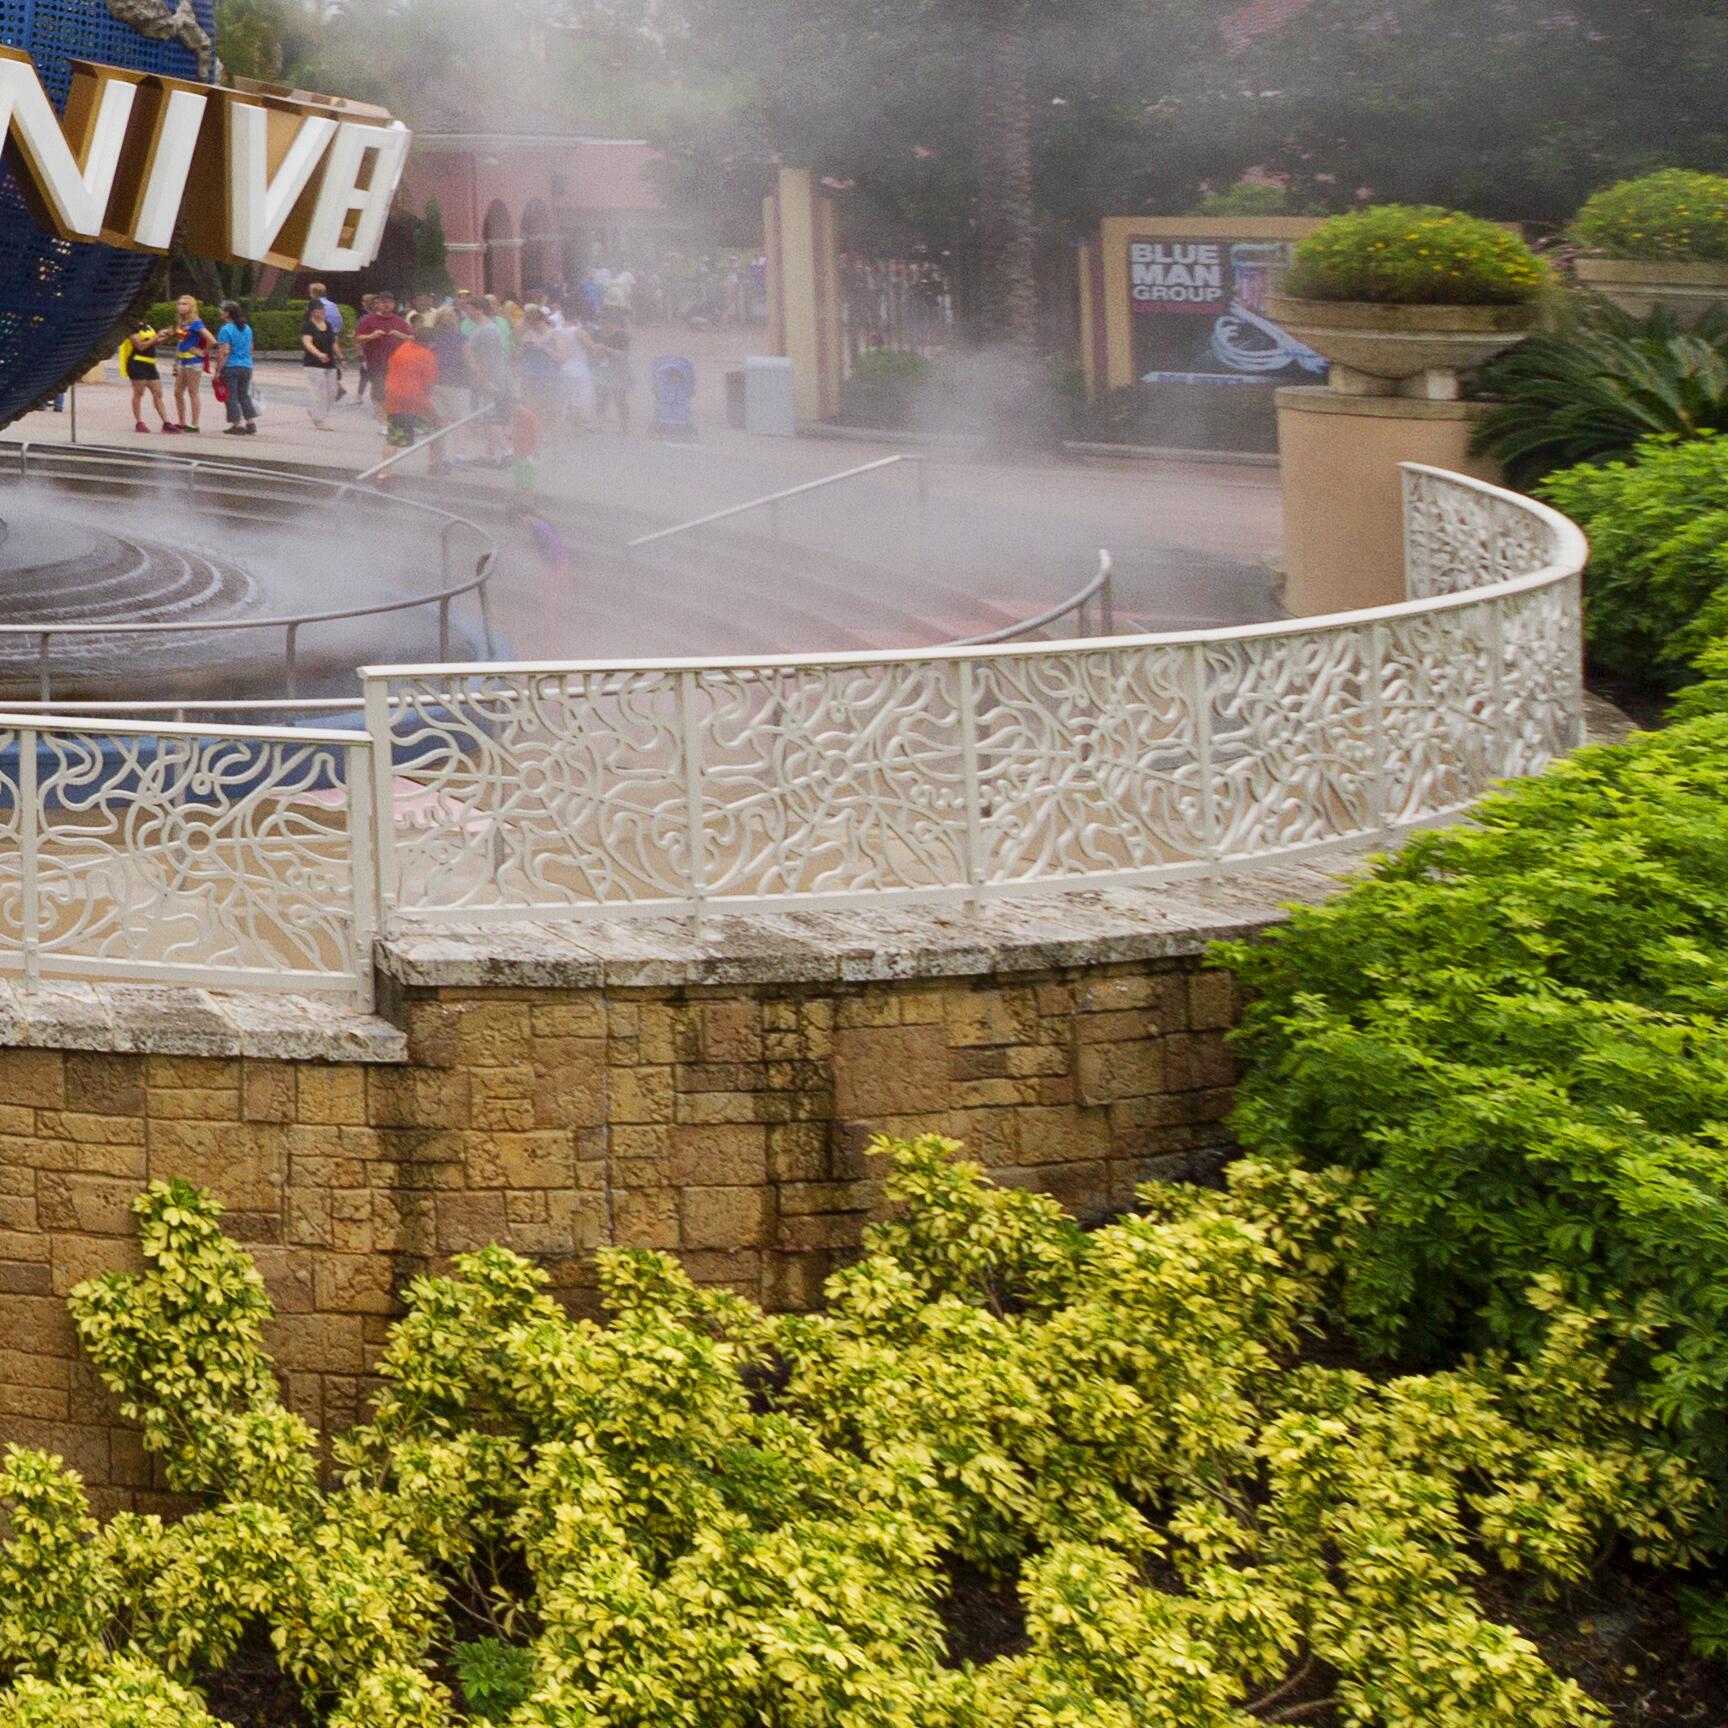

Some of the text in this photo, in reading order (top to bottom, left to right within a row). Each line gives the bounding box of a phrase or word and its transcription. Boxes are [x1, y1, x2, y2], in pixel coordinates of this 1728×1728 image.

[1130, 244, 1219, 264] BLUE
[1132, 264, 1221, 286] MAN
[1132, 286, 1224, 302] GROUP
